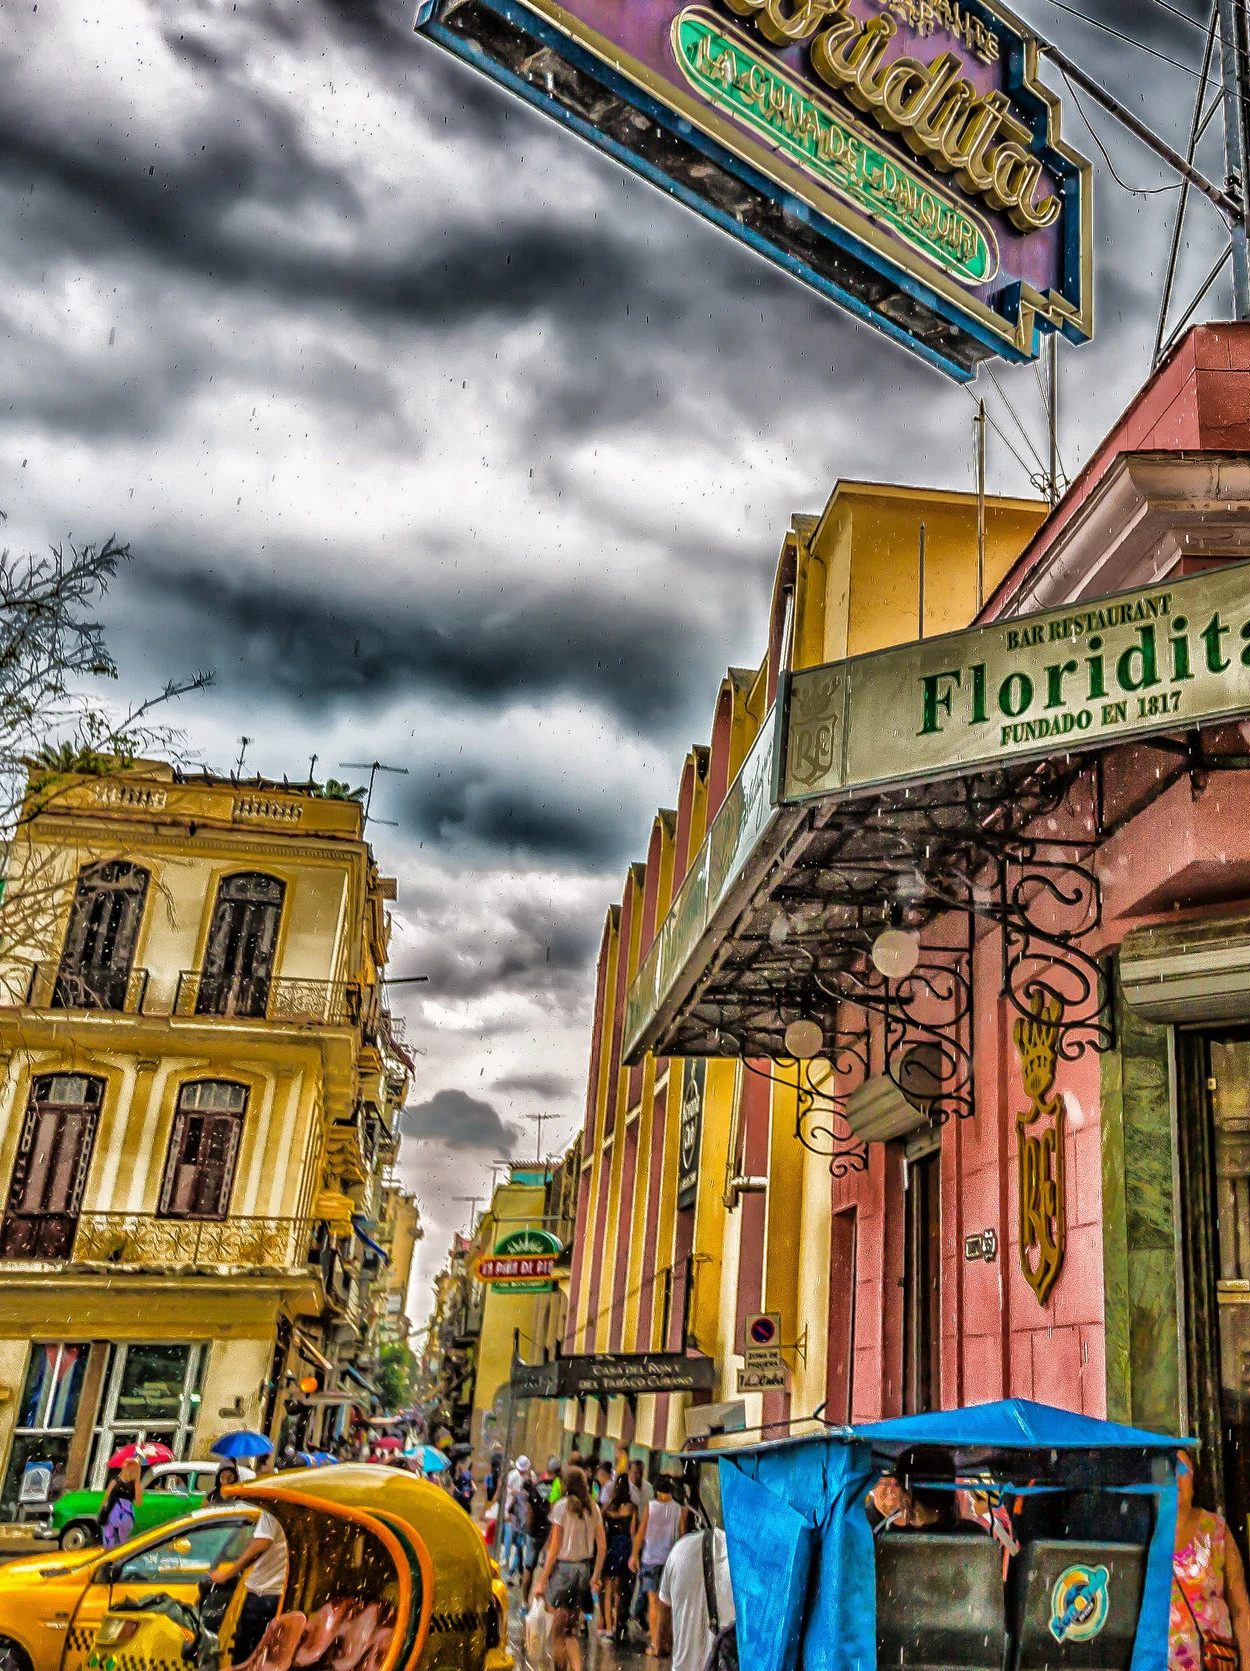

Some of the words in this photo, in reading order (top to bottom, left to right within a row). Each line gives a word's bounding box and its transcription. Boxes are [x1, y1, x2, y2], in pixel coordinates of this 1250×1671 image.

[695, 34, 738, 89] LA
[739, 64, 821, 148] CUNA
[871, 162, 980, 263] DAIQUIRI
[1006, 624, 1043, 652] BAR
[1048, 592, 1174, 643] RESTAURANT
[1001, 708, 1092, 746] FUNDADO
[1101, 699, 1128, 727] EN
[1136, 690, 1183, 718] 1817
